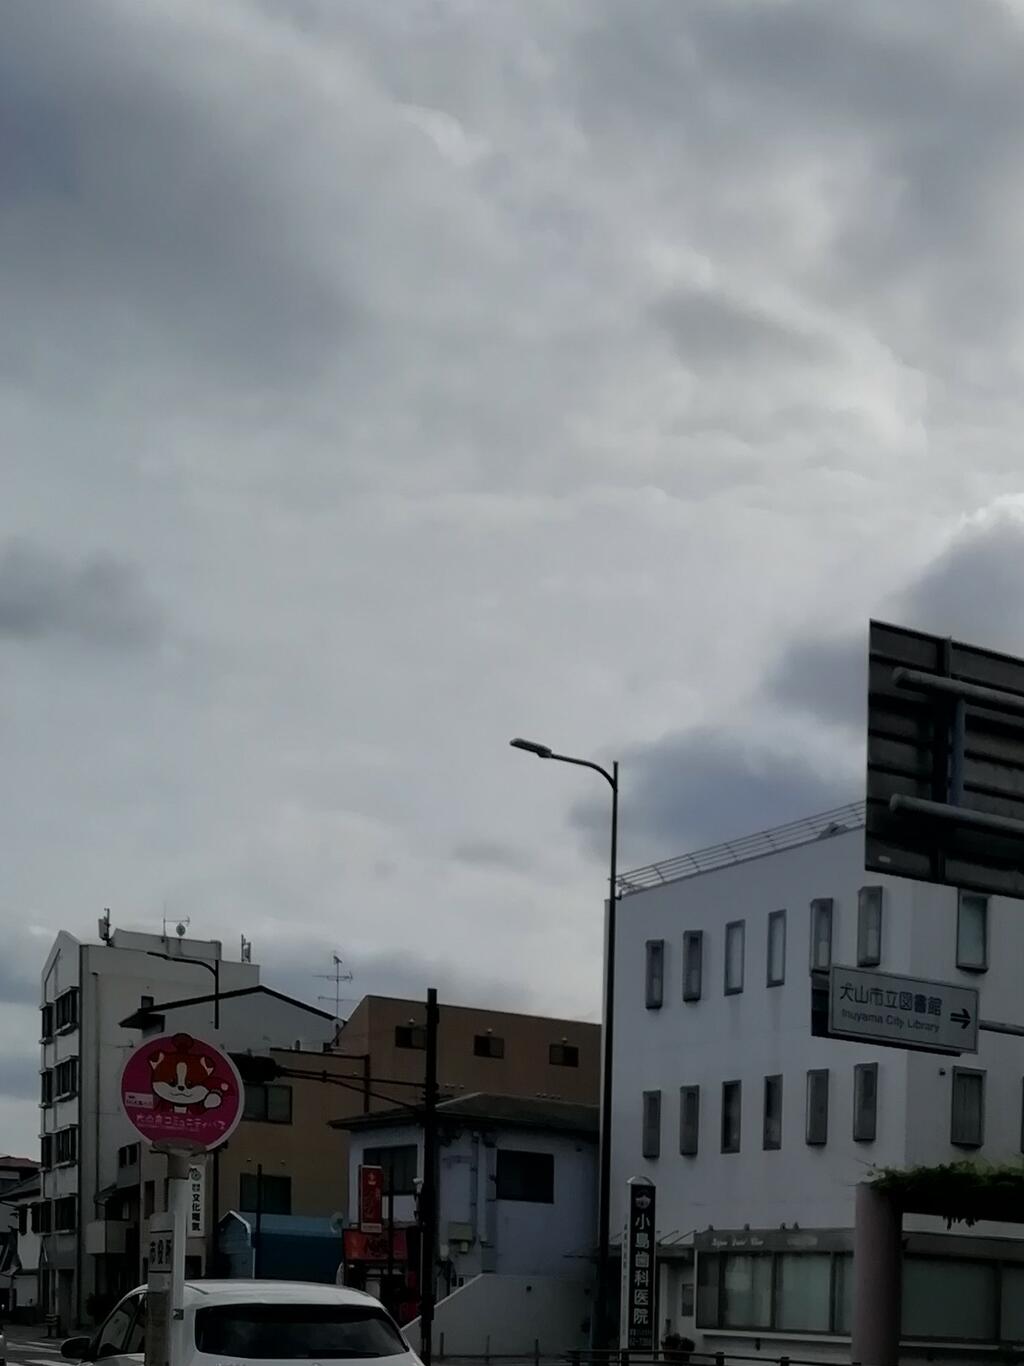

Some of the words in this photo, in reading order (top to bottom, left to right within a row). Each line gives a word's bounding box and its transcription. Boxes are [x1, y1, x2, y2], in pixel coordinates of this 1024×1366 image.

[840, 982, 942, 1016] 犬山市立図書館
[842, 1008, 884, 1024] Inuyama
[886, 1014, 905, 1029] City
[907, 1017, 940, 1033] Library
[633, 1213, 651, 1325] 小島歯科医院
